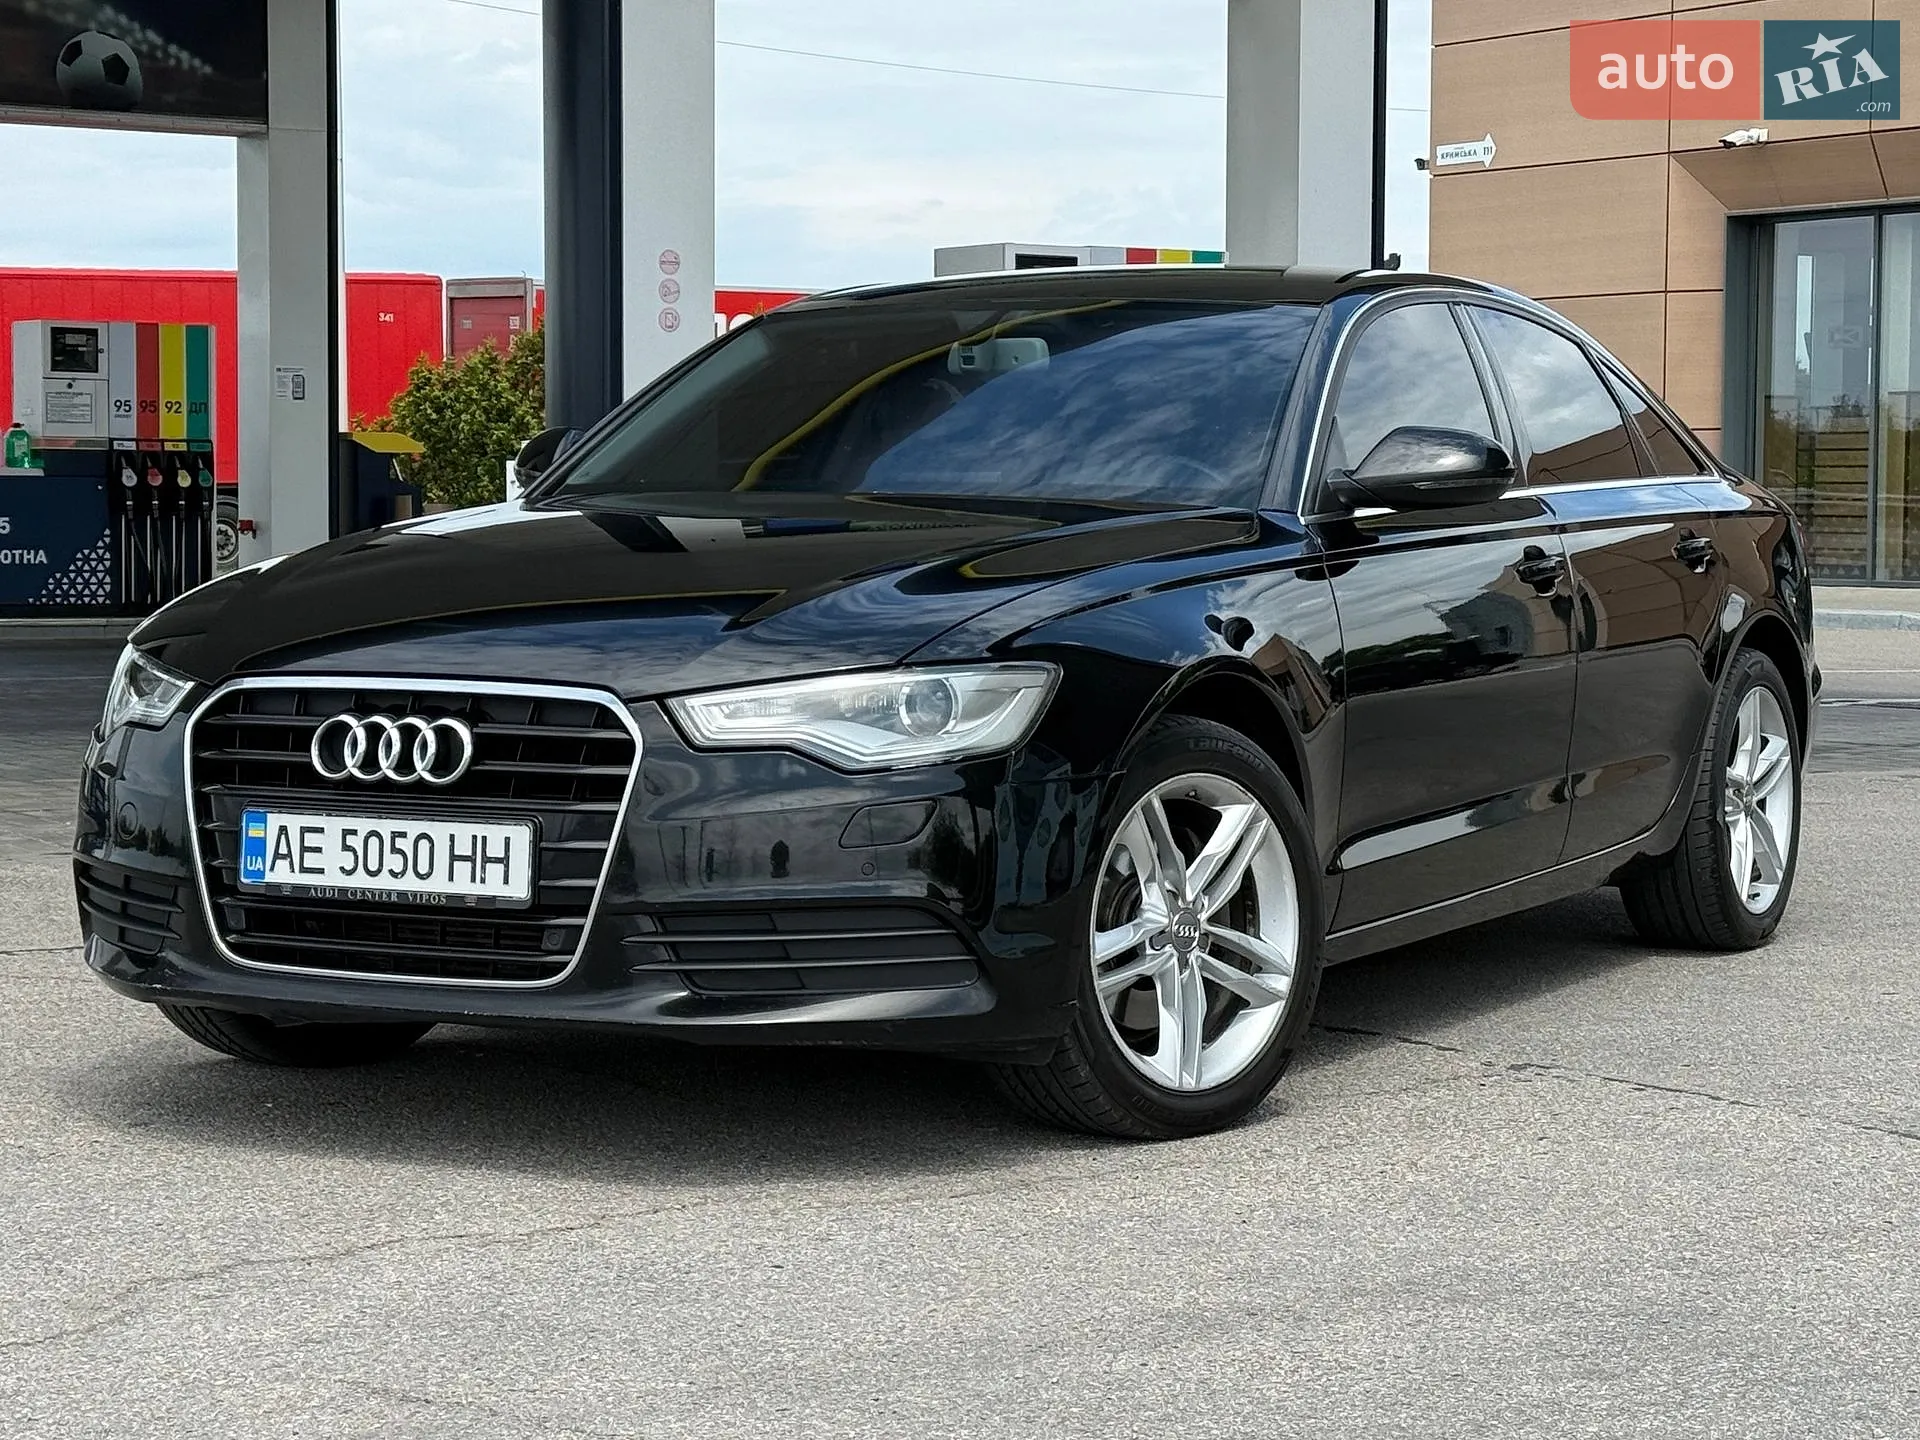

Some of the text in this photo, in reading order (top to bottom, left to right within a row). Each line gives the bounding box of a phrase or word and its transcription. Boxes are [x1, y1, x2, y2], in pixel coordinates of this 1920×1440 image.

[378, 312, 394, 323] 341
[114, 399, 132, 413] 95
[140, 400, 157, 414] 95
[165, 401, 182, 414] 92
[269, 824, 511, 886] AE 5050 HH
[247, 855, 263, 872] UA
[308, 886, 447, 905] AUDI CENTER VIPOS
